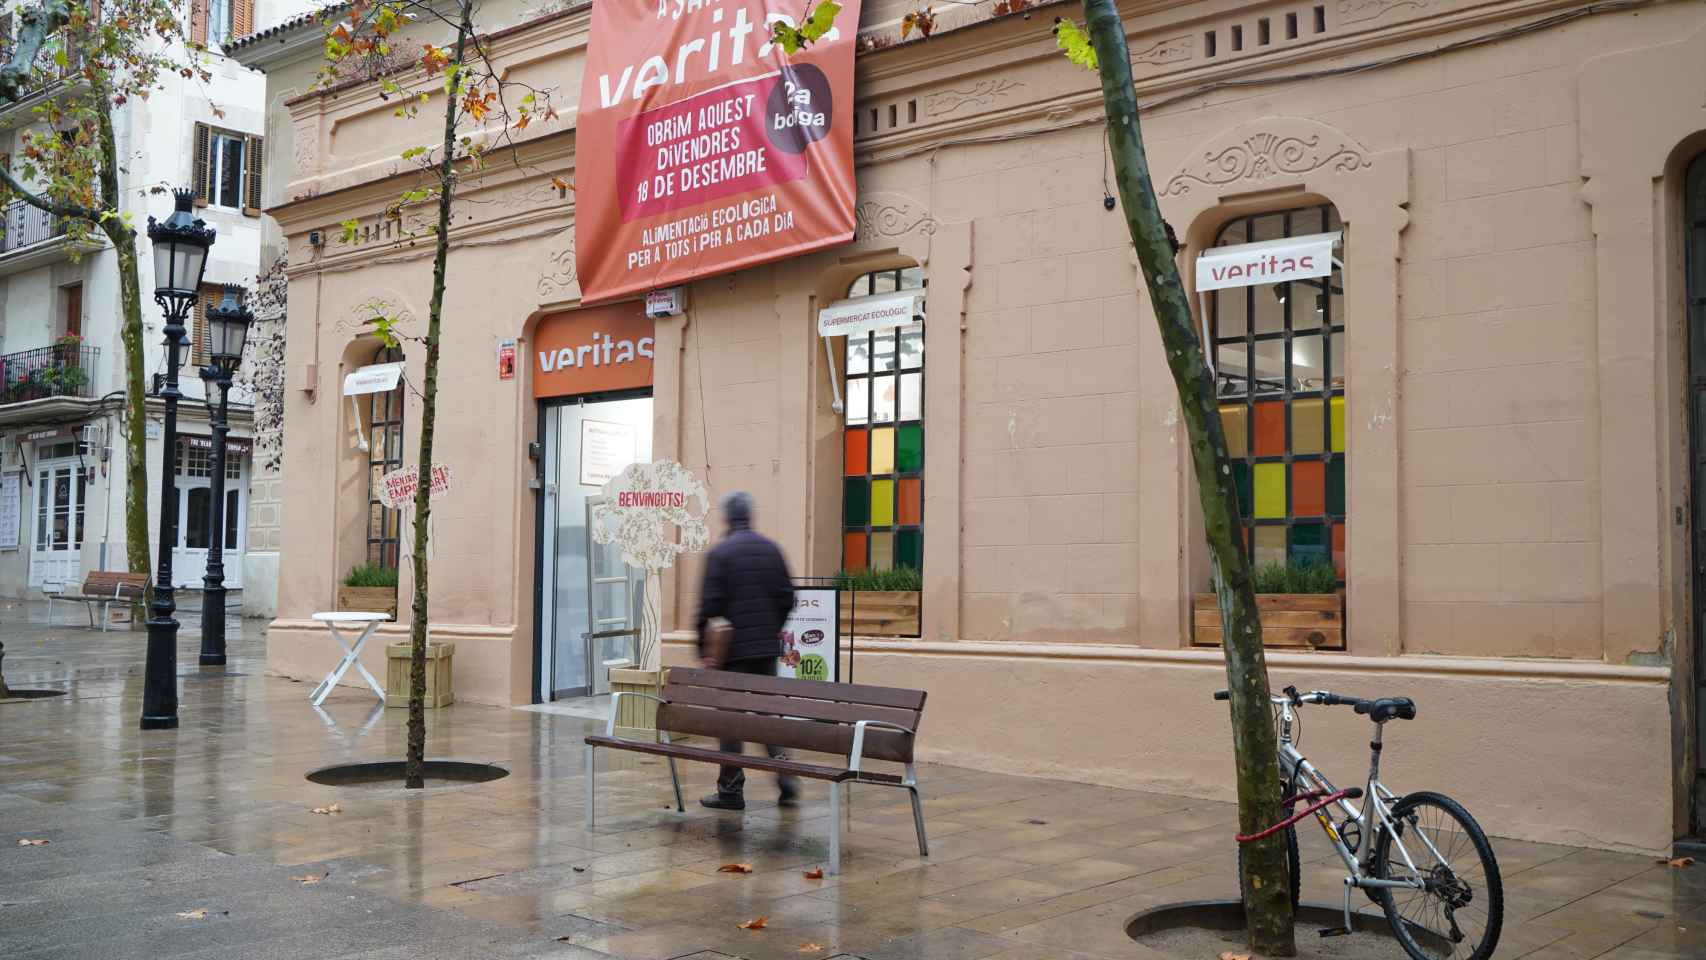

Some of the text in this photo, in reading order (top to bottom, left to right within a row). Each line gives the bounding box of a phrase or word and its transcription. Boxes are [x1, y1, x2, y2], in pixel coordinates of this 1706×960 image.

[698, 94, 756, 132] AQUEST
[637, 147, 767, 203] 18 DE DESEMBRE
[628, 249, 651, 271] PER
[654, 247, 661, 263] A
[665, 239, 690, 262] TOTS
[700, 231, 722, 251] PER
[725, 226, 733, 245] A
[736, 219, 770, 242] CADA
[1211, 255, 1314, 281] veritas
[823, 313, 870, 327] SUPERMERCAT
[539, 331, 655, 373] veritas
[800, 659, 823, 675] 10%
